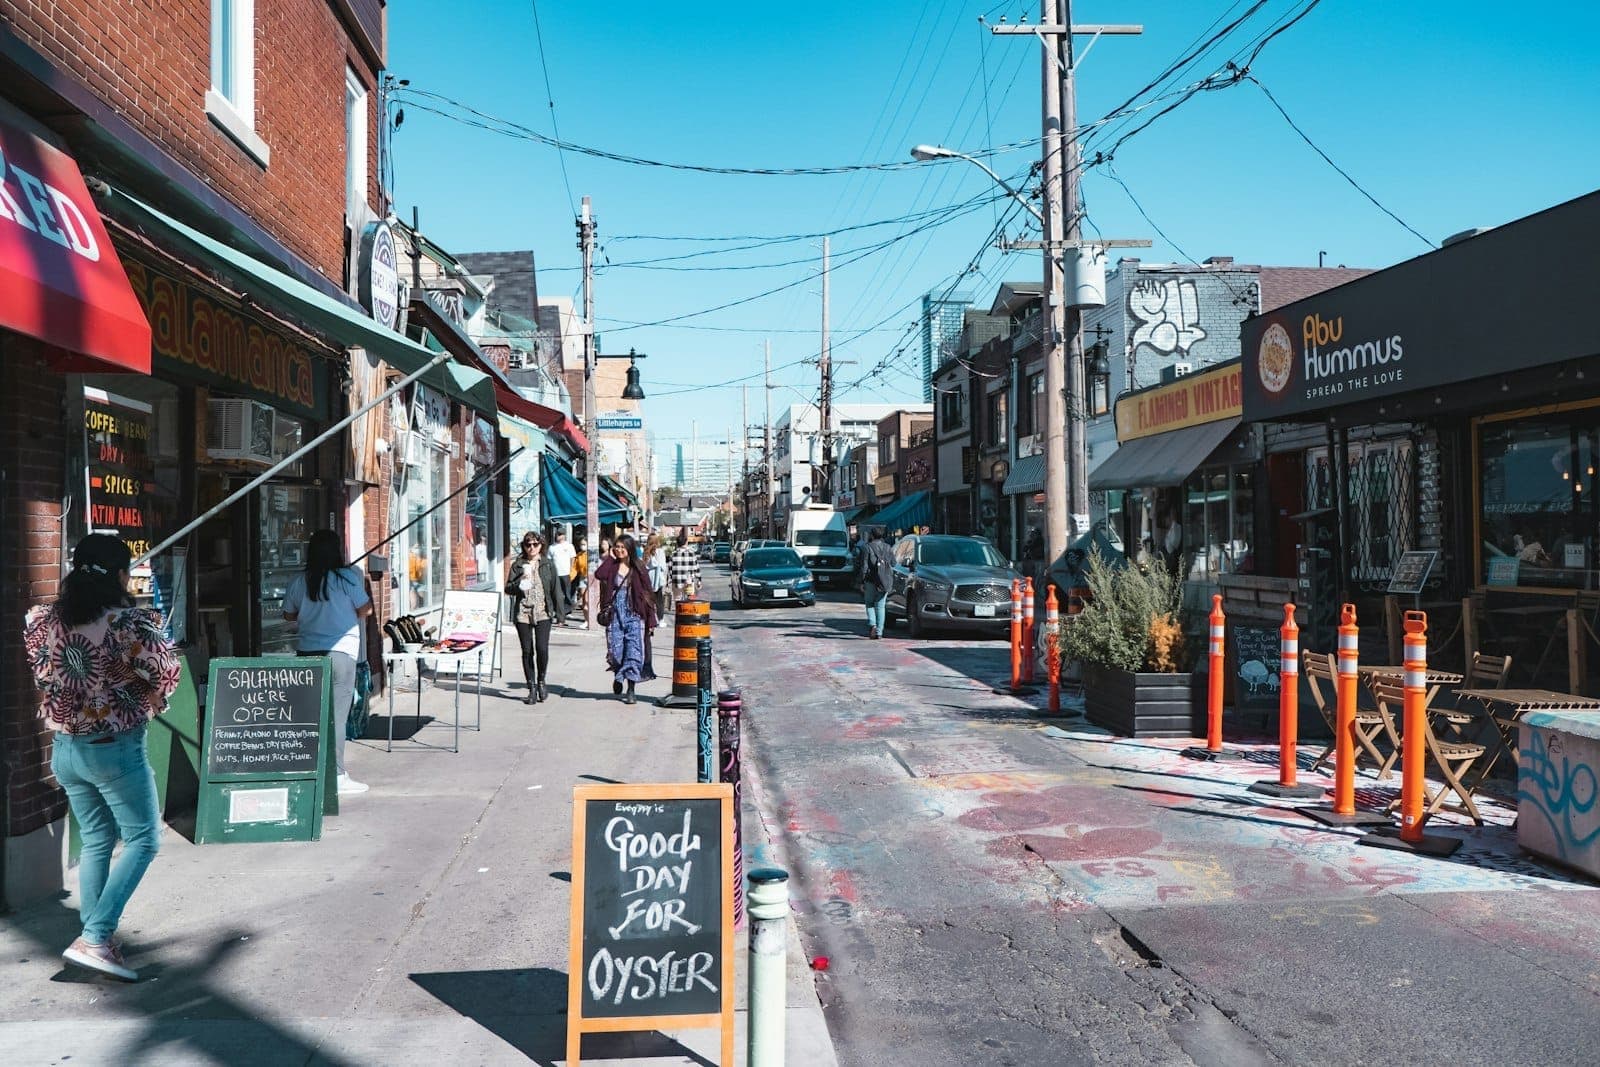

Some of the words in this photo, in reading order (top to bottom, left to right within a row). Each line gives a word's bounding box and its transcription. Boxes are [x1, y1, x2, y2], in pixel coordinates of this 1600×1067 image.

[1303, 313, 1343, 349] Abu
[1304, 335, 1403, 380] Hummus
[1306, 382, 1344, 399] SPREAD
[1348, 377, 1369, 390] THE
[1373, 369, 1403, 385] LOVE
[1138, 387, 1189, 430] FLAMINGO
[105, 474, 140, 496] SPICES
[228, 669, 314, 689] SALAMANCA
[242, 690, 288, 704] WE'RE
[233, 705, 293, 723] OPEN
[654, 803, 665, 813] is
[604, 808, 701, 872] Good
[620, 860, 693, 898] DAY
[608, 898, 702, 940] FOR
[588, 947, 718, 1005] OYSTER
